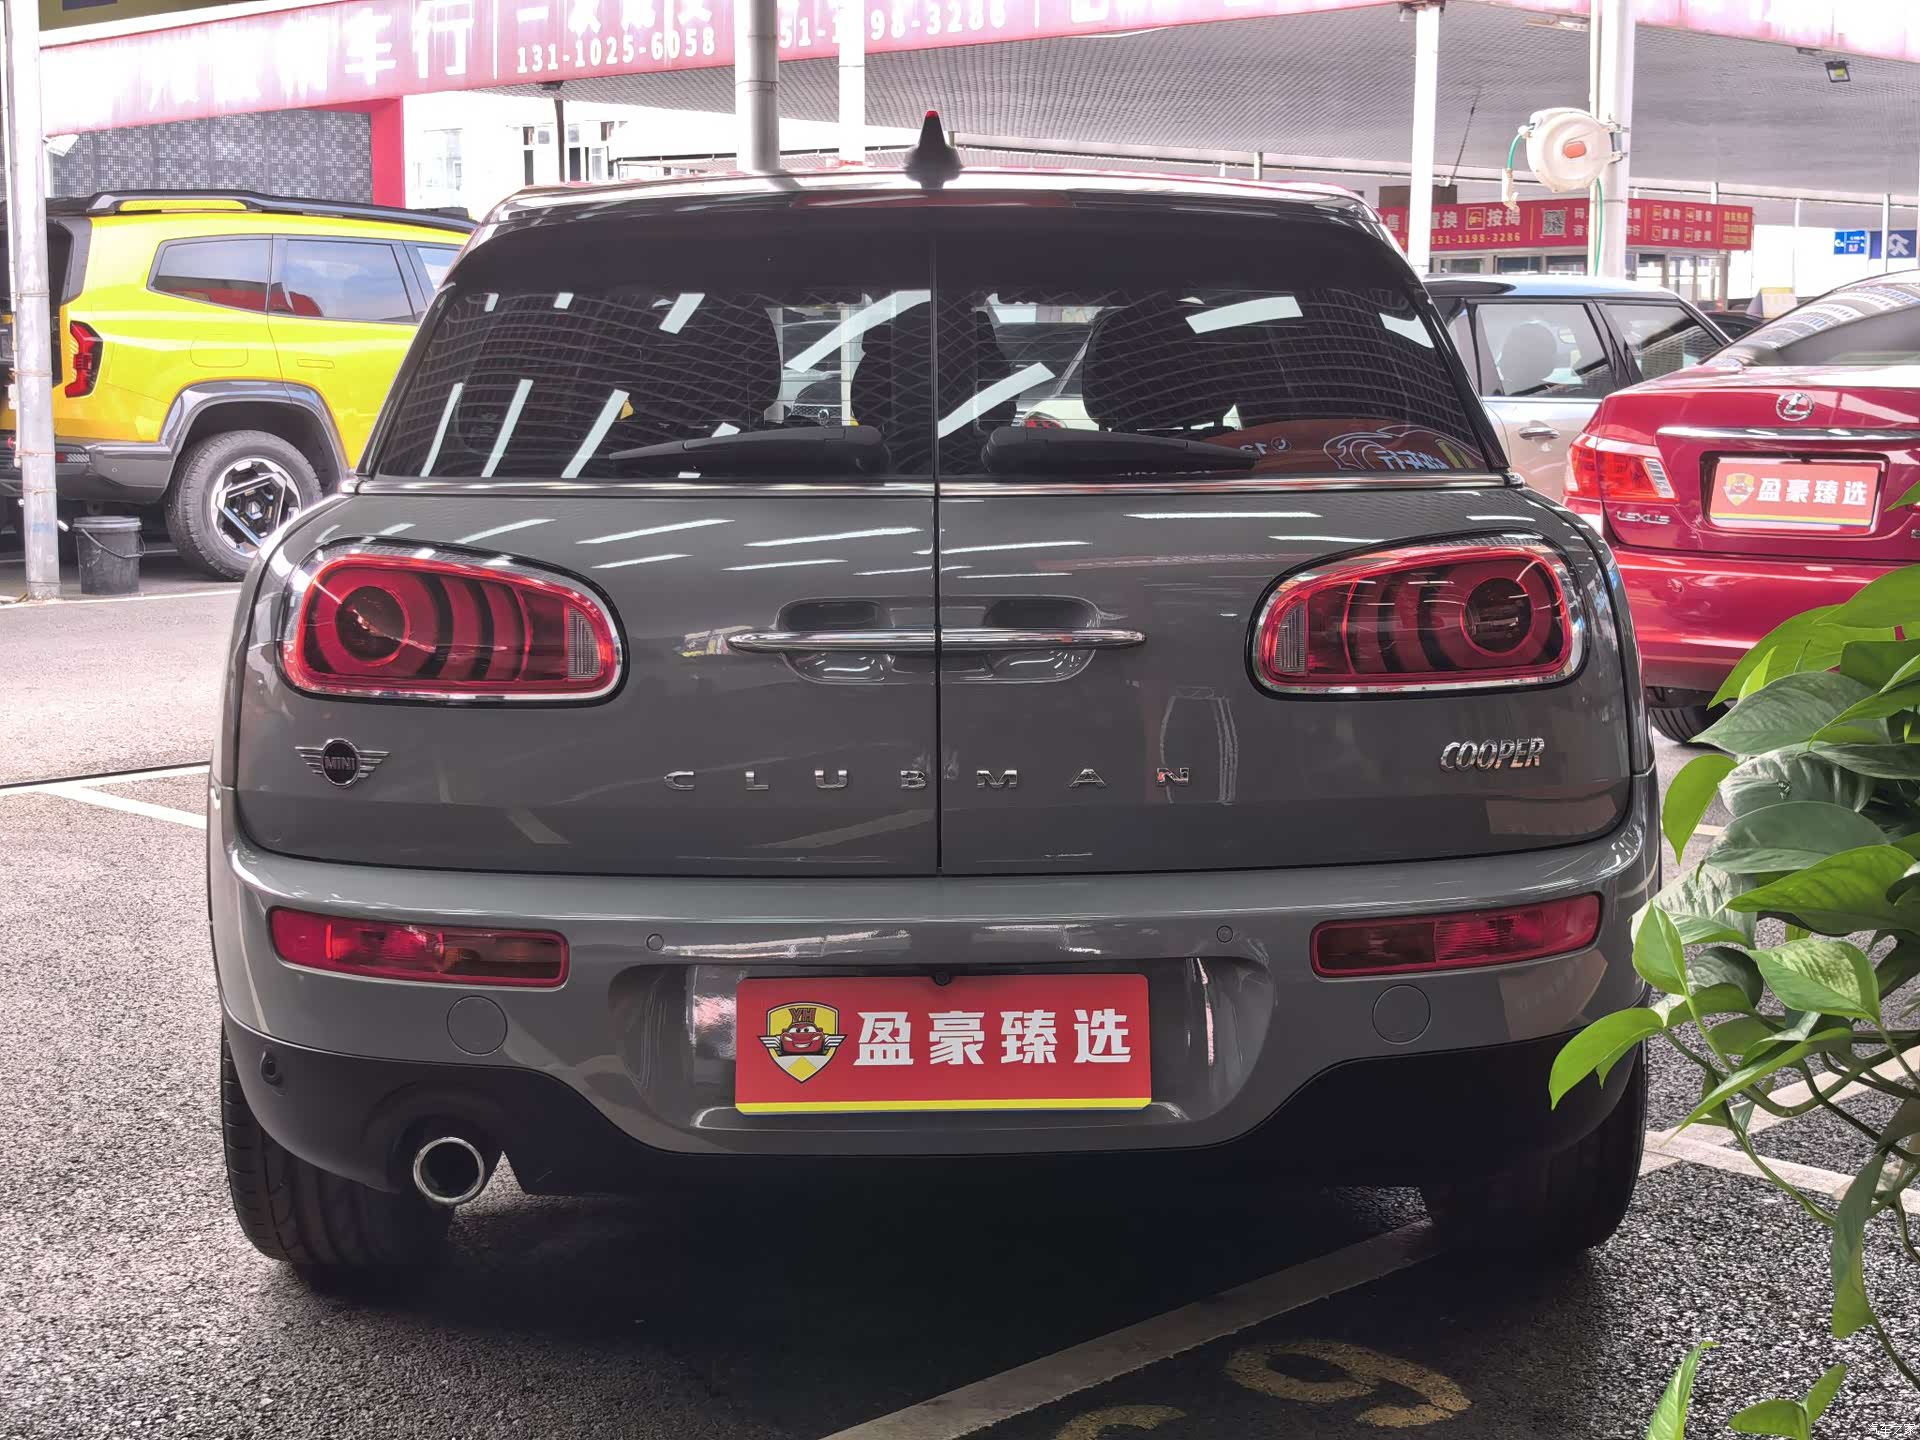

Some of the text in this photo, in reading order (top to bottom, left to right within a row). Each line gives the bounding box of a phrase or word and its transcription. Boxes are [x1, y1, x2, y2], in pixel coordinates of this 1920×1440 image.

[516, 27, 715, 73] 131-1025-6058
[1616, 511, 1671, 525] LEXUS
[324, 756, 356, 771] MINI
[1440, 736, 1545, 770] COOPER
[788, 1007, 817, 1023] YH
[853, 1008, 1131, 1067] 盈豪臻选
